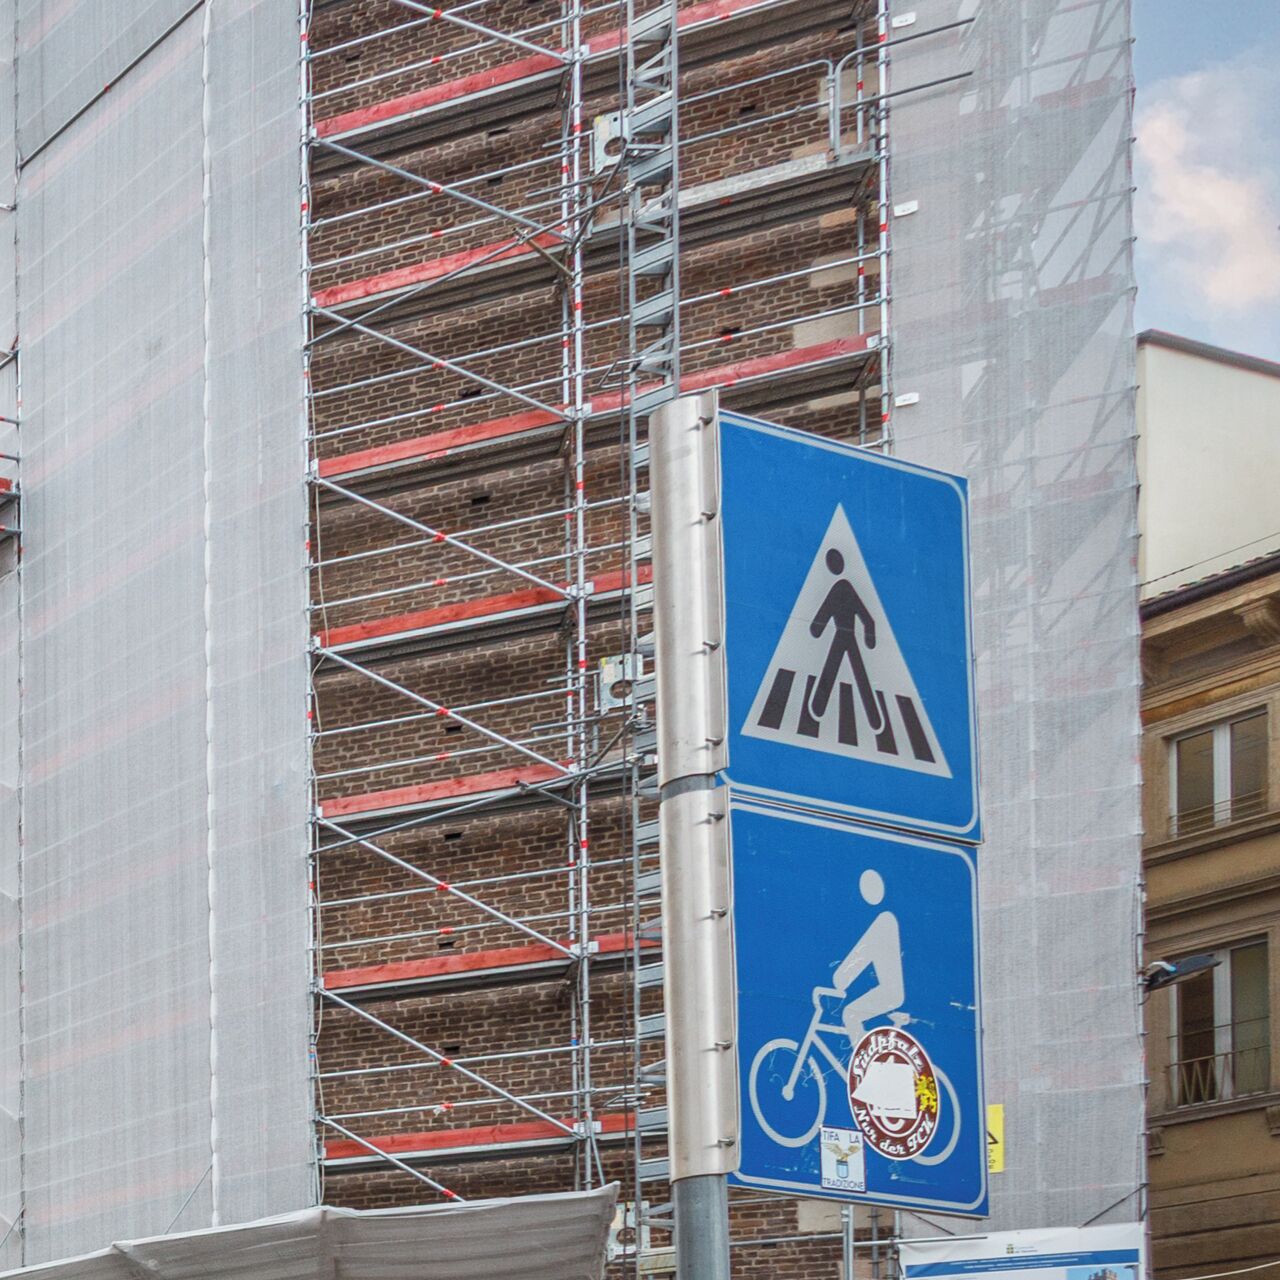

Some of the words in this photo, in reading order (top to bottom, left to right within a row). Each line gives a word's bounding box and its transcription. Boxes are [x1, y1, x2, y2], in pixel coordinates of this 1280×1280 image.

[823, 1130, 840, 1142] TIFA
[849, 1133, 860, 1144] LA
[854, 1105, 878, 1142] Nur
[880, 1140, 906, 1155] der
[823, 1177, 864, 1190] TRADIZIONE
